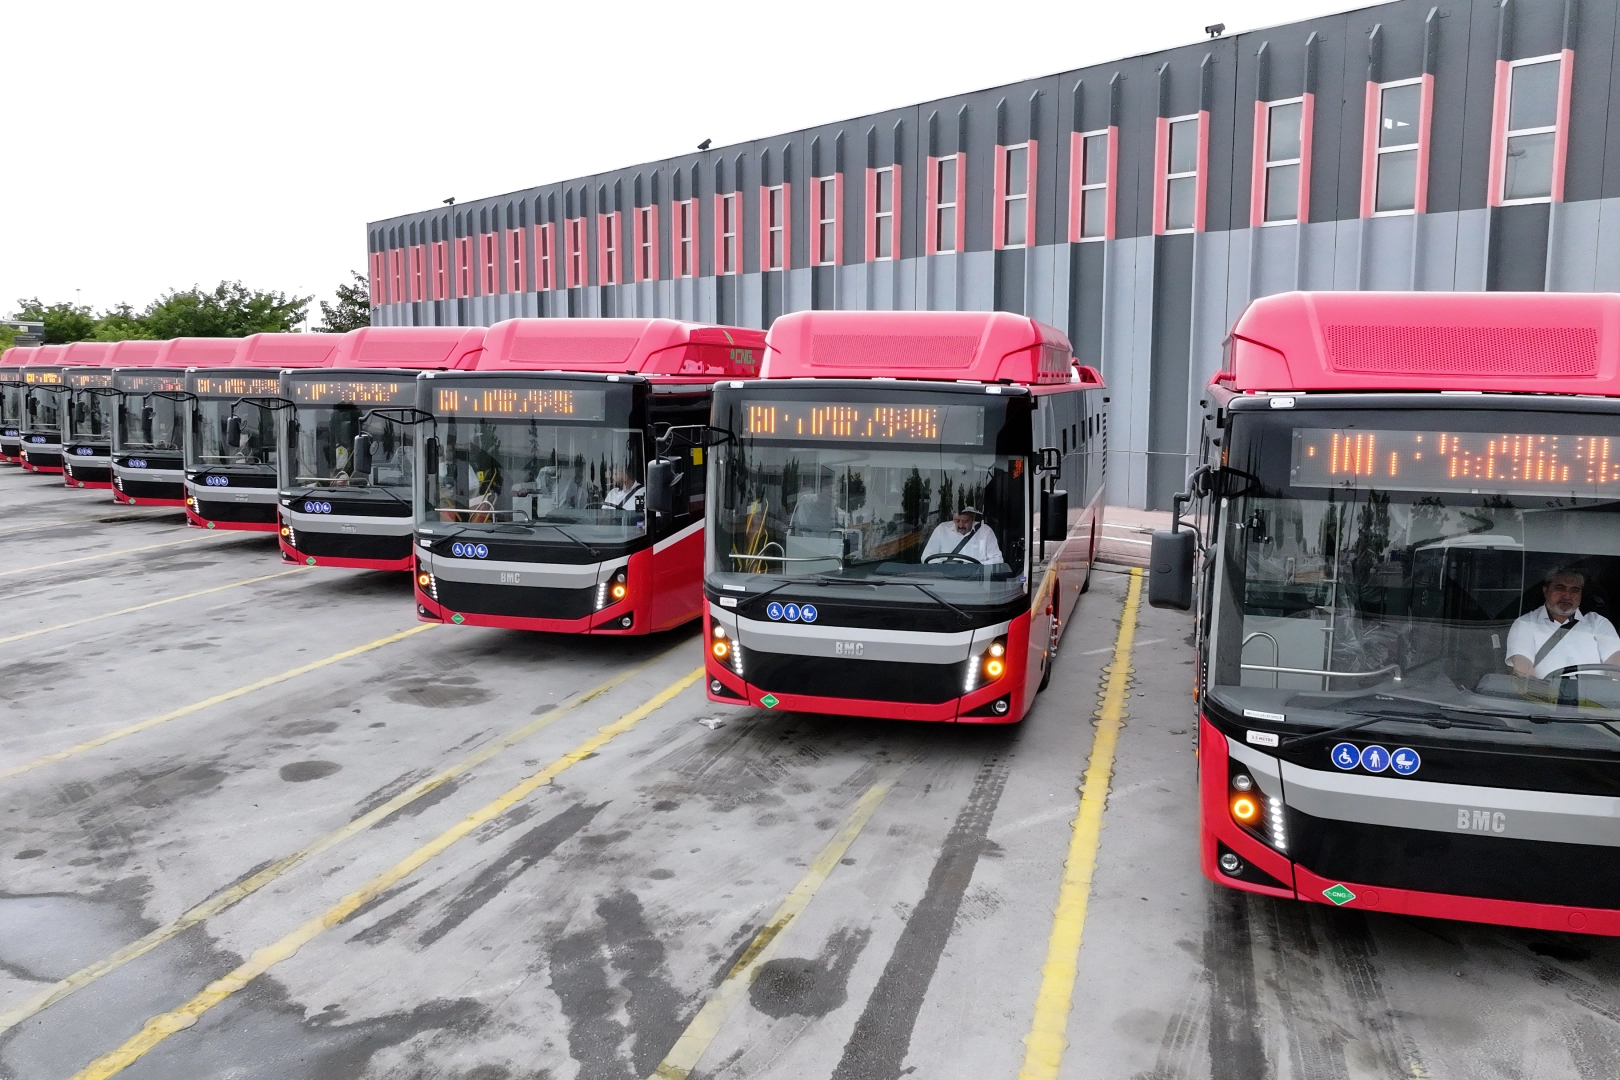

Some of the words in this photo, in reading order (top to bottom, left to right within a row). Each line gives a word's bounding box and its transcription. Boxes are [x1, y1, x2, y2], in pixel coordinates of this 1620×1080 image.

[735, 348, 753, 365] CNG
[500, 572, 521, 584] BMC
[835, 641, 864, 656] BMC
[1457, 809, 1506, 833] BMC
[1332, 891, 1347, 899] CNG
